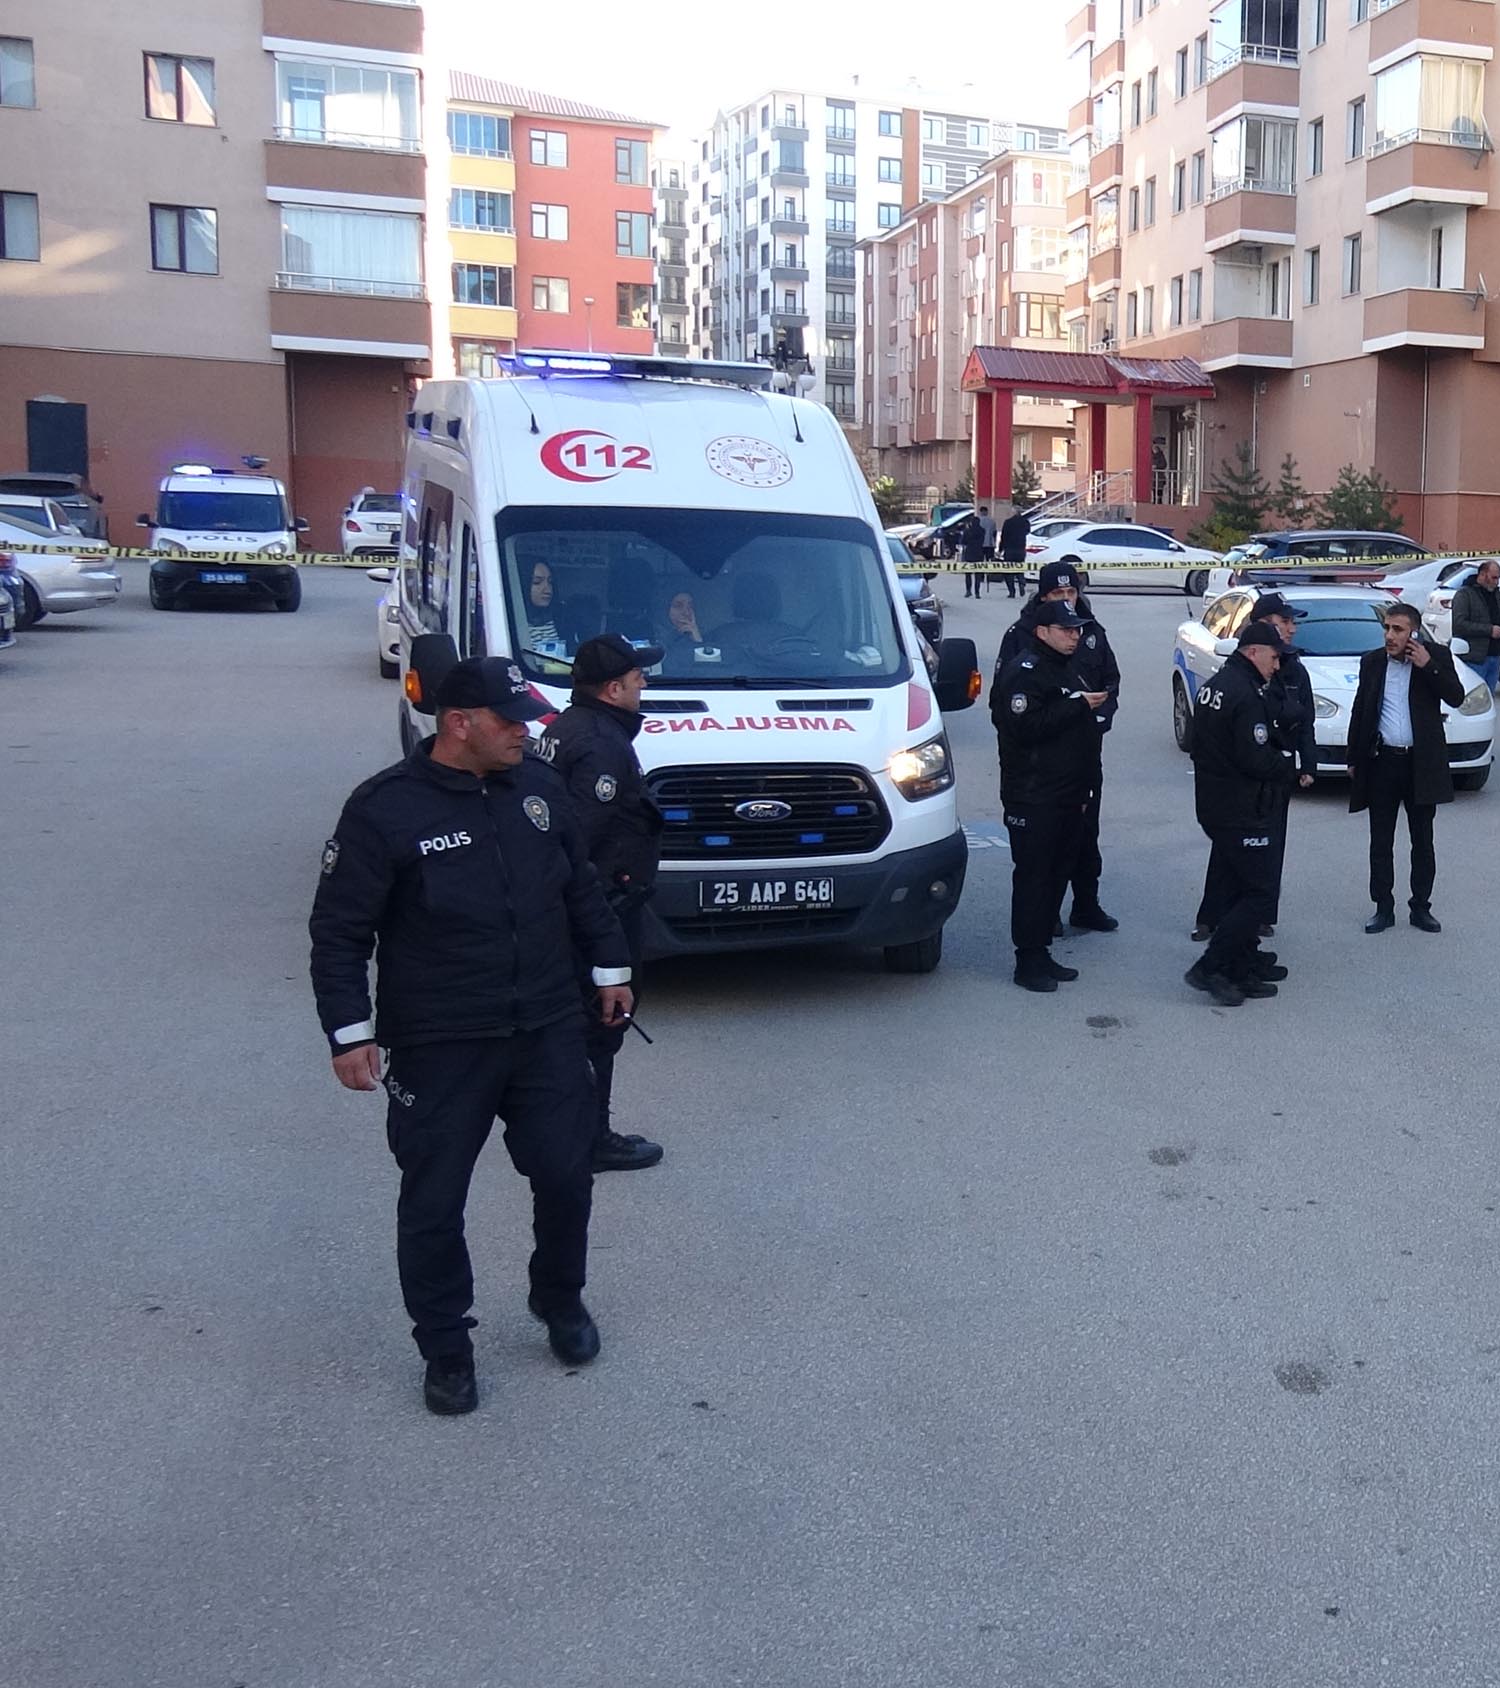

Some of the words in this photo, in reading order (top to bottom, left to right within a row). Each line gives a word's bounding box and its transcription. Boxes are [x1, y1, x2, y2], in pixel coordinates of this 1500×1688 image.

[565, 443, 653, 470] 112
[749, 804, 781, 817] Ford
[714, 882, 739, 904] 25
[750, 882, 787, 903] AAP
[794, 880, 830, 901] 648
